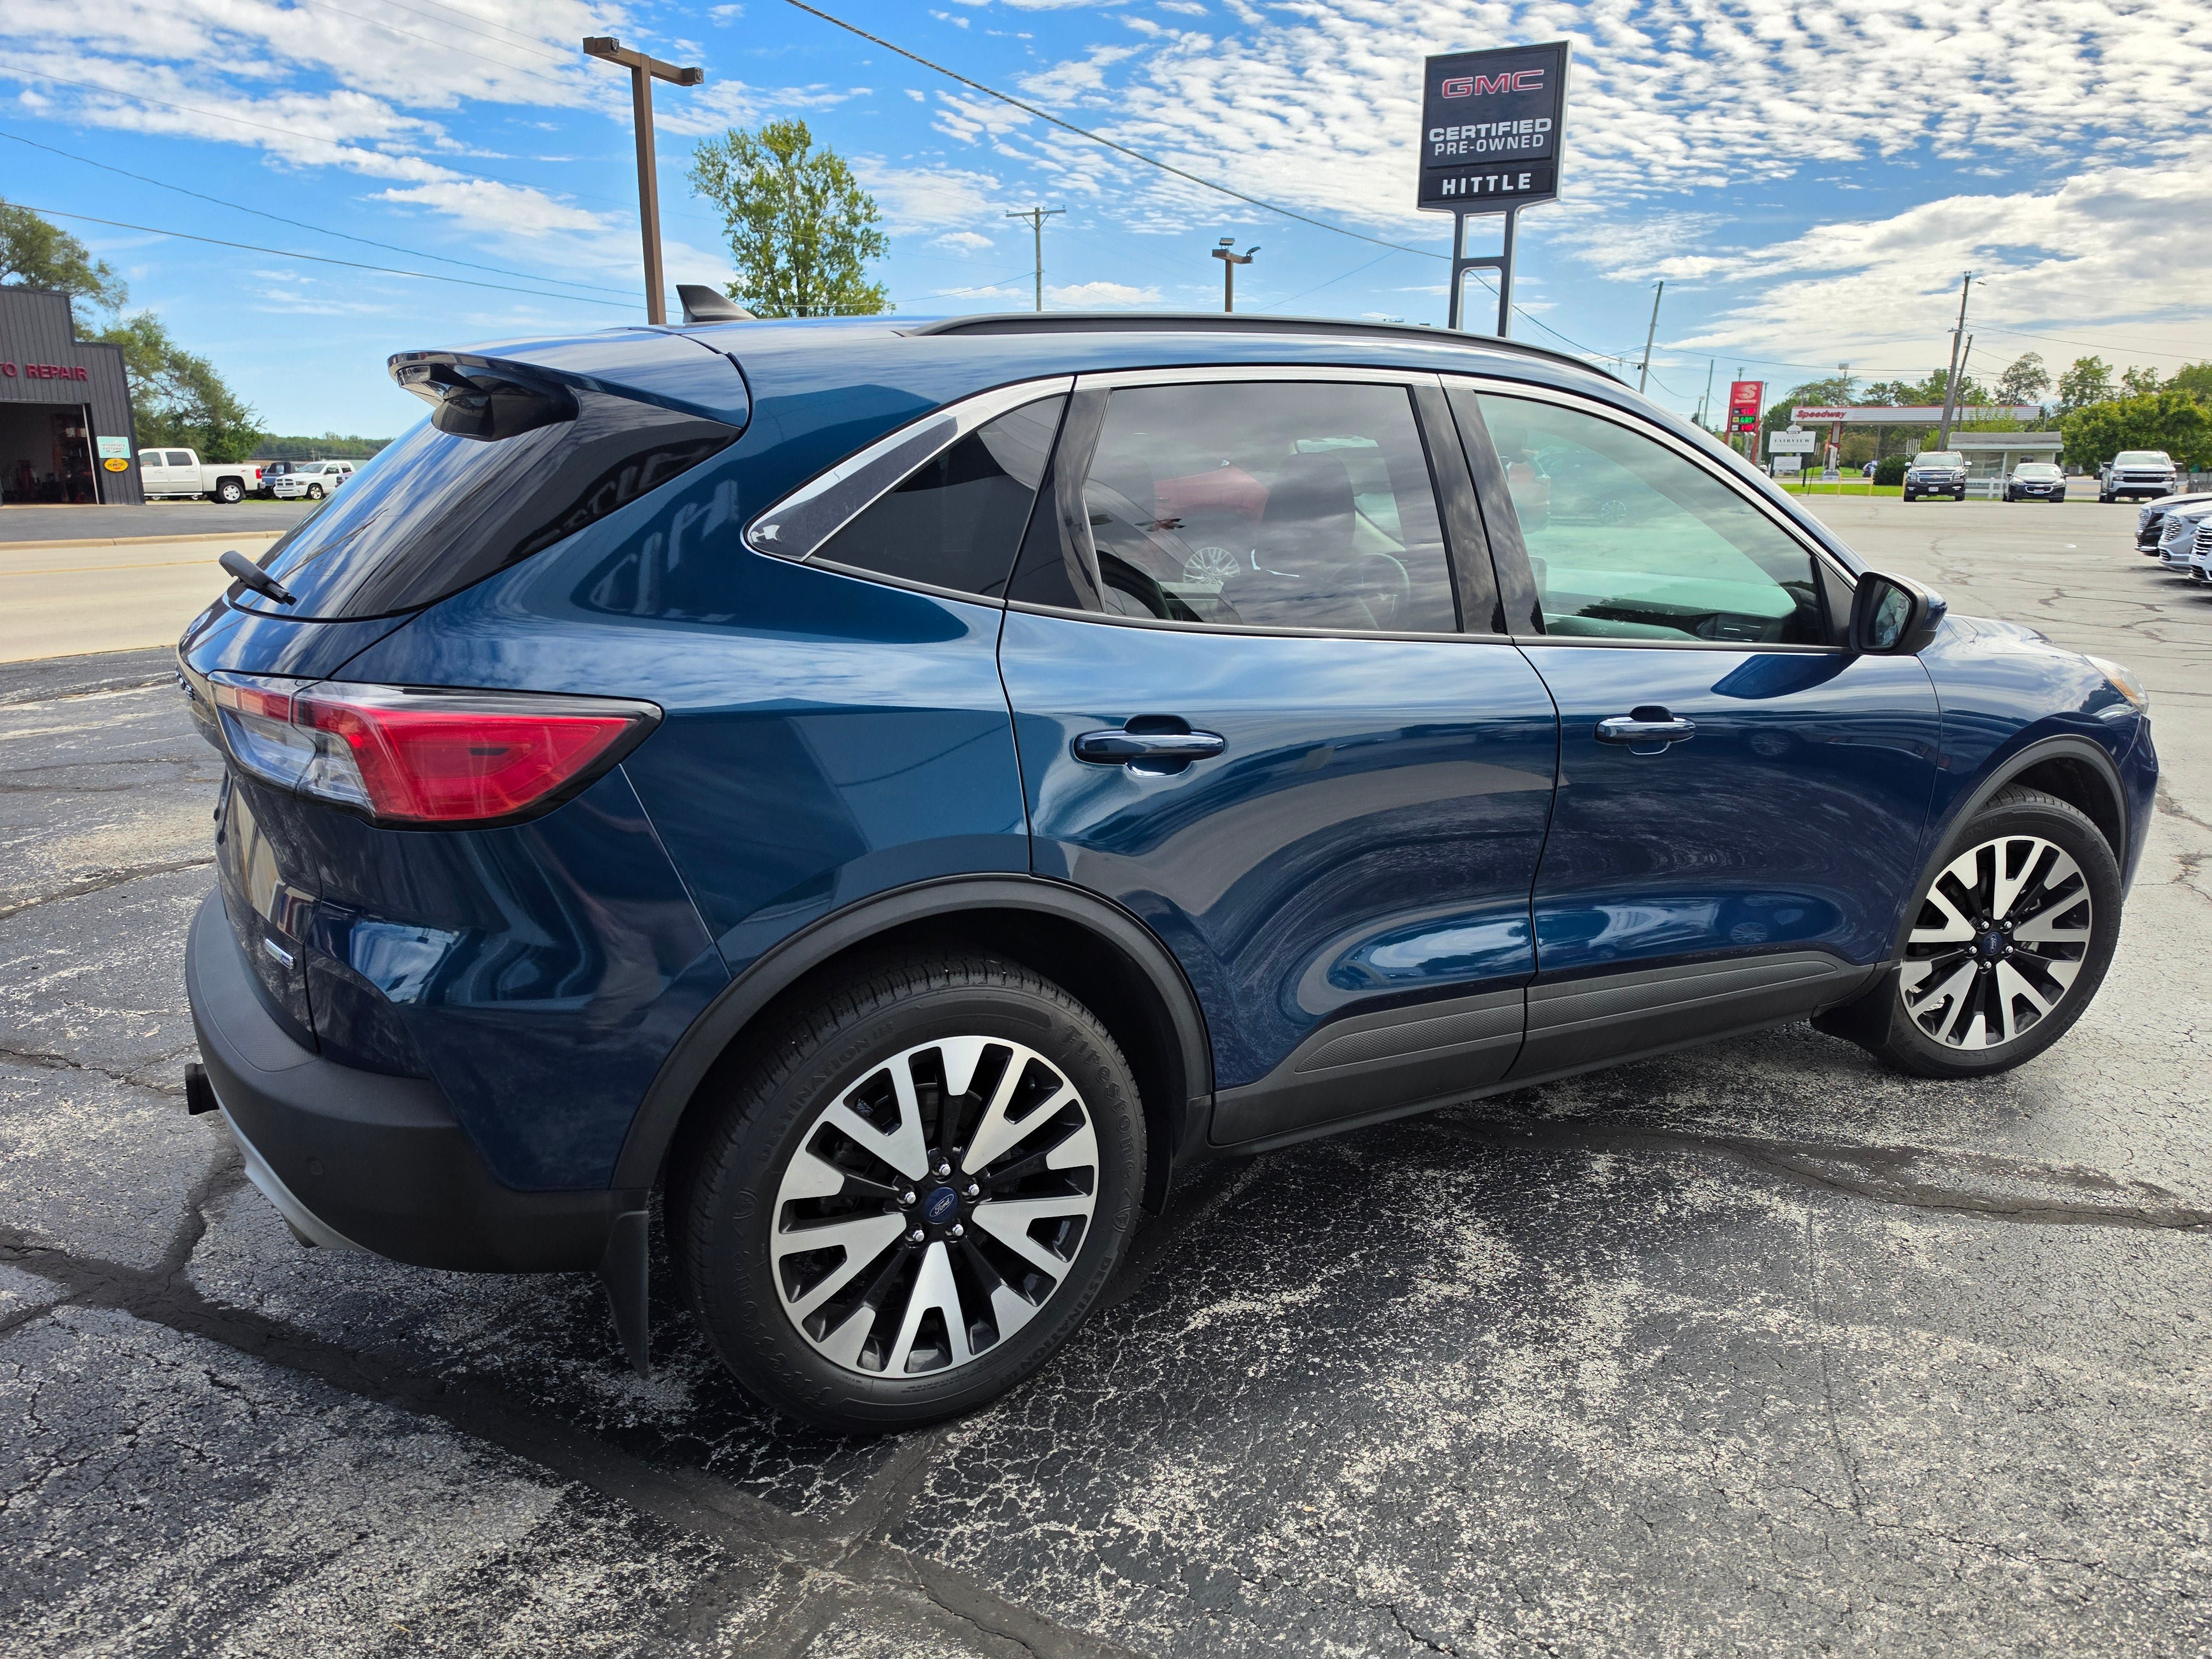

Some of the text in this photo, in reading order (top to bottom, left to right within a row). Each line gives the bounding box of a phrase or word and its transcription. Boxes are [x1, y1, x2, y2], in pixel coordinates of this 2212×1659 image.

[1442, 69, 1545, 99] GMC
[1428, 117, 1552, 142] CERTIFIED
[1434, 134, 1545, 156] PRE-OWNED
[1442, 173, 1532, 195] HITTLE
[26, 363, 88, 382] REPAIR
[1796, 410, 1847, 420] Speedway
[1060, 1025, 1135, 1178] Firestone
